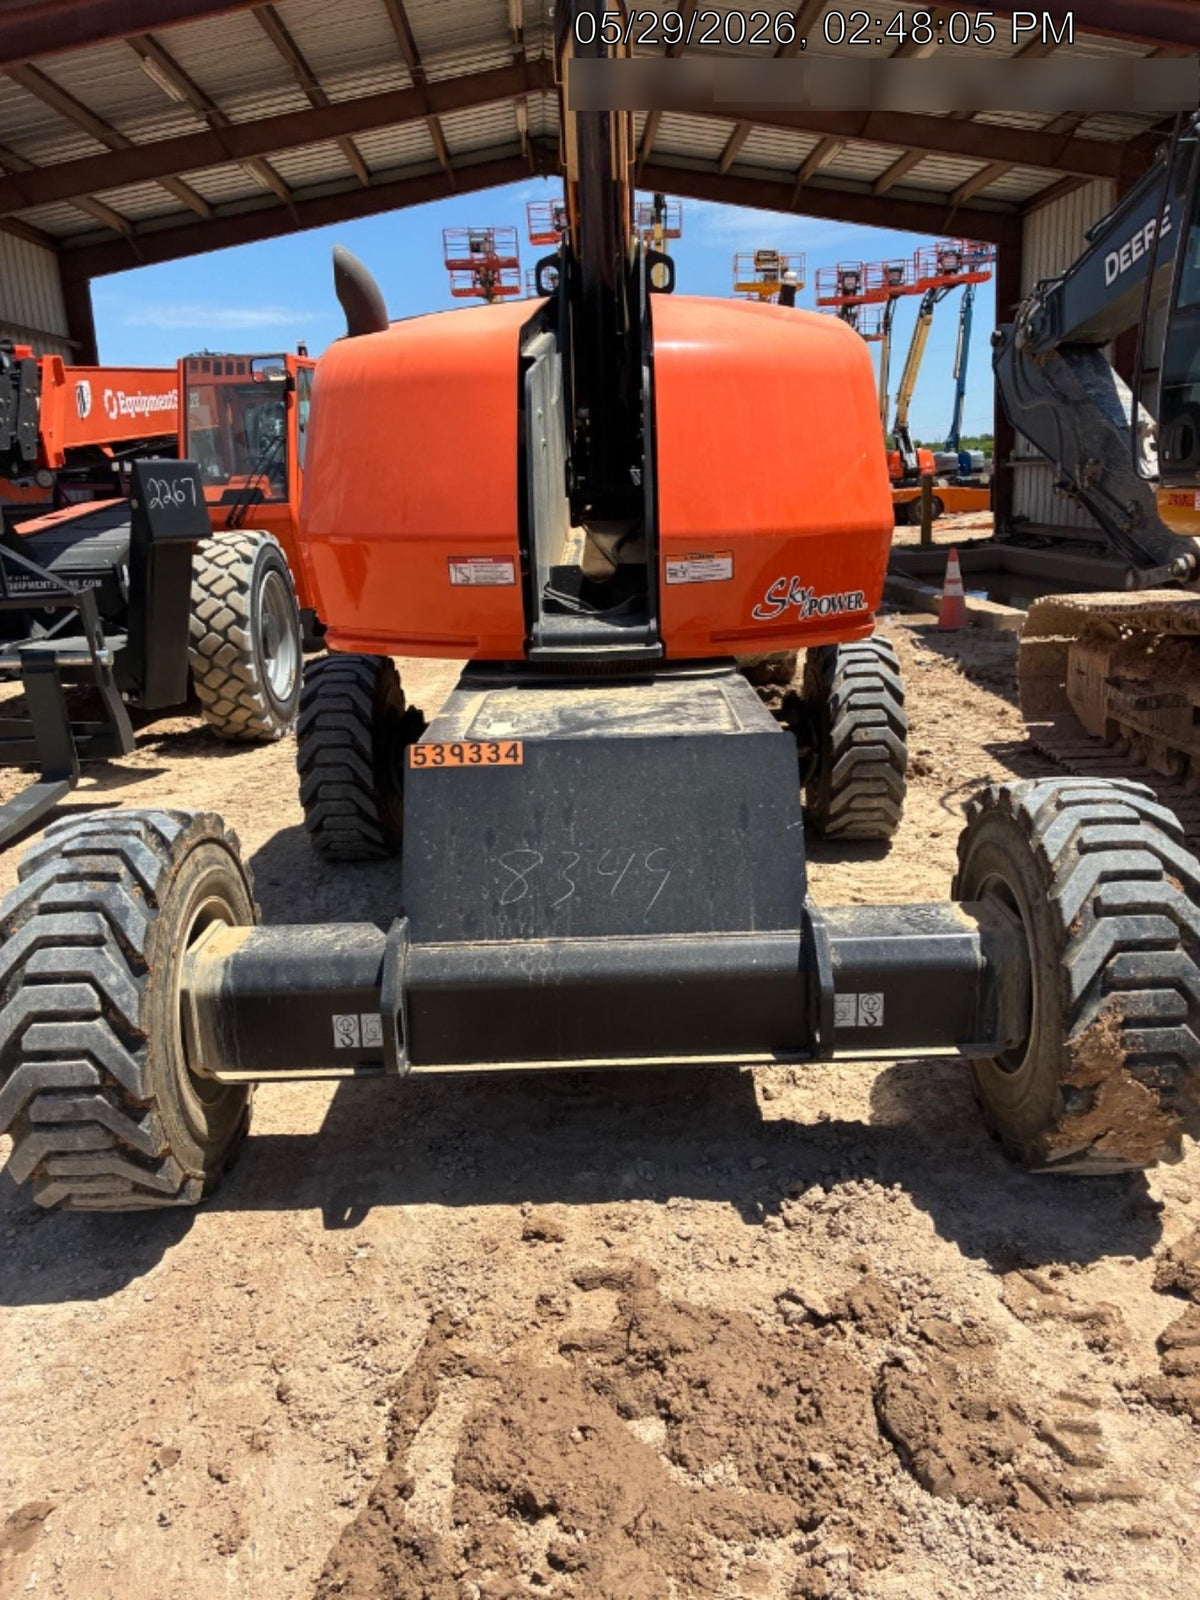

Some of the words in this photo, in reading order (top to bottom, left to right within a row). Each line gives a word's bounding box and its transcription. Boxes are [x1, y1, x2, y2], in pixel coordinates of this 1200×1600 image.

[1105, 204, 1172, 287] DEERE
[147, 478, 196, 509] 2267
[413, 742, 519, 765] 539334
